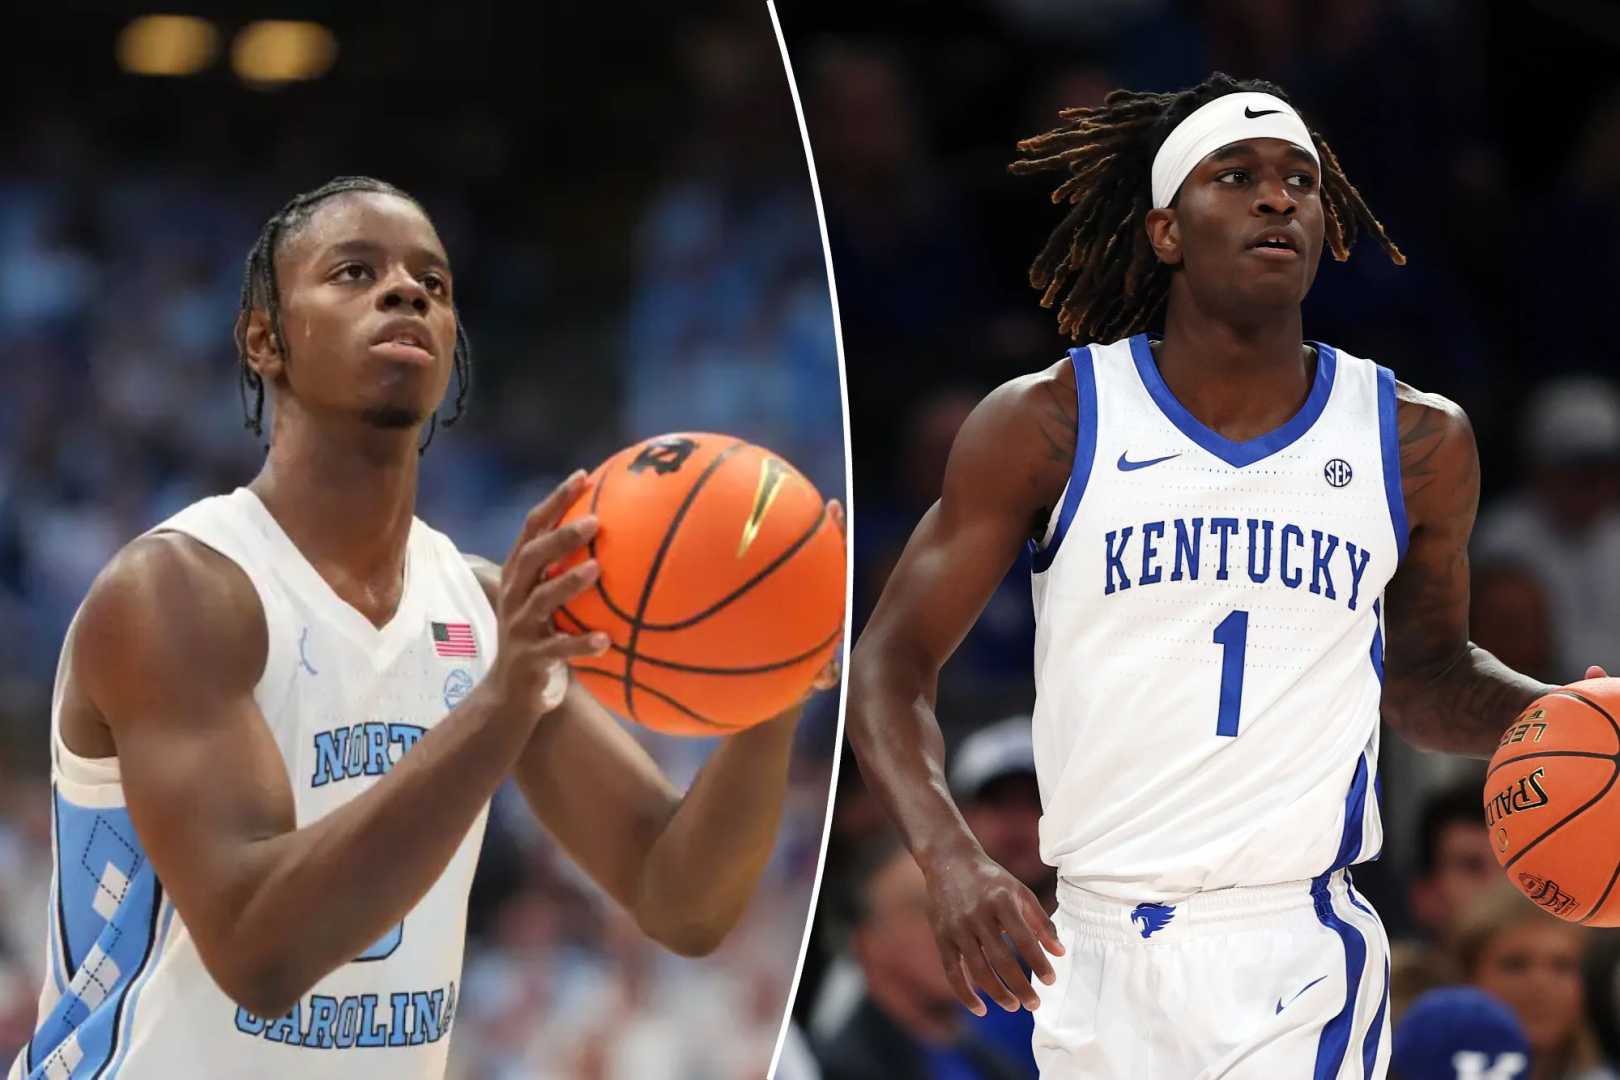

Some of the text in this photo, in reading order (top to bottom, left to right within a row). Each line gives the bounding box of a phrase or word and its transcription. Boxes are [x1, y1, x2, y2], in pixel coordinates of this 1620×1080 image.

[1324, 458, 1353, 488] SEC
[1104, 517, 1371, 611] KENTUCKY
[1212, 609, 1249, 738] 1
[311, 722, 431, 788] NORT
